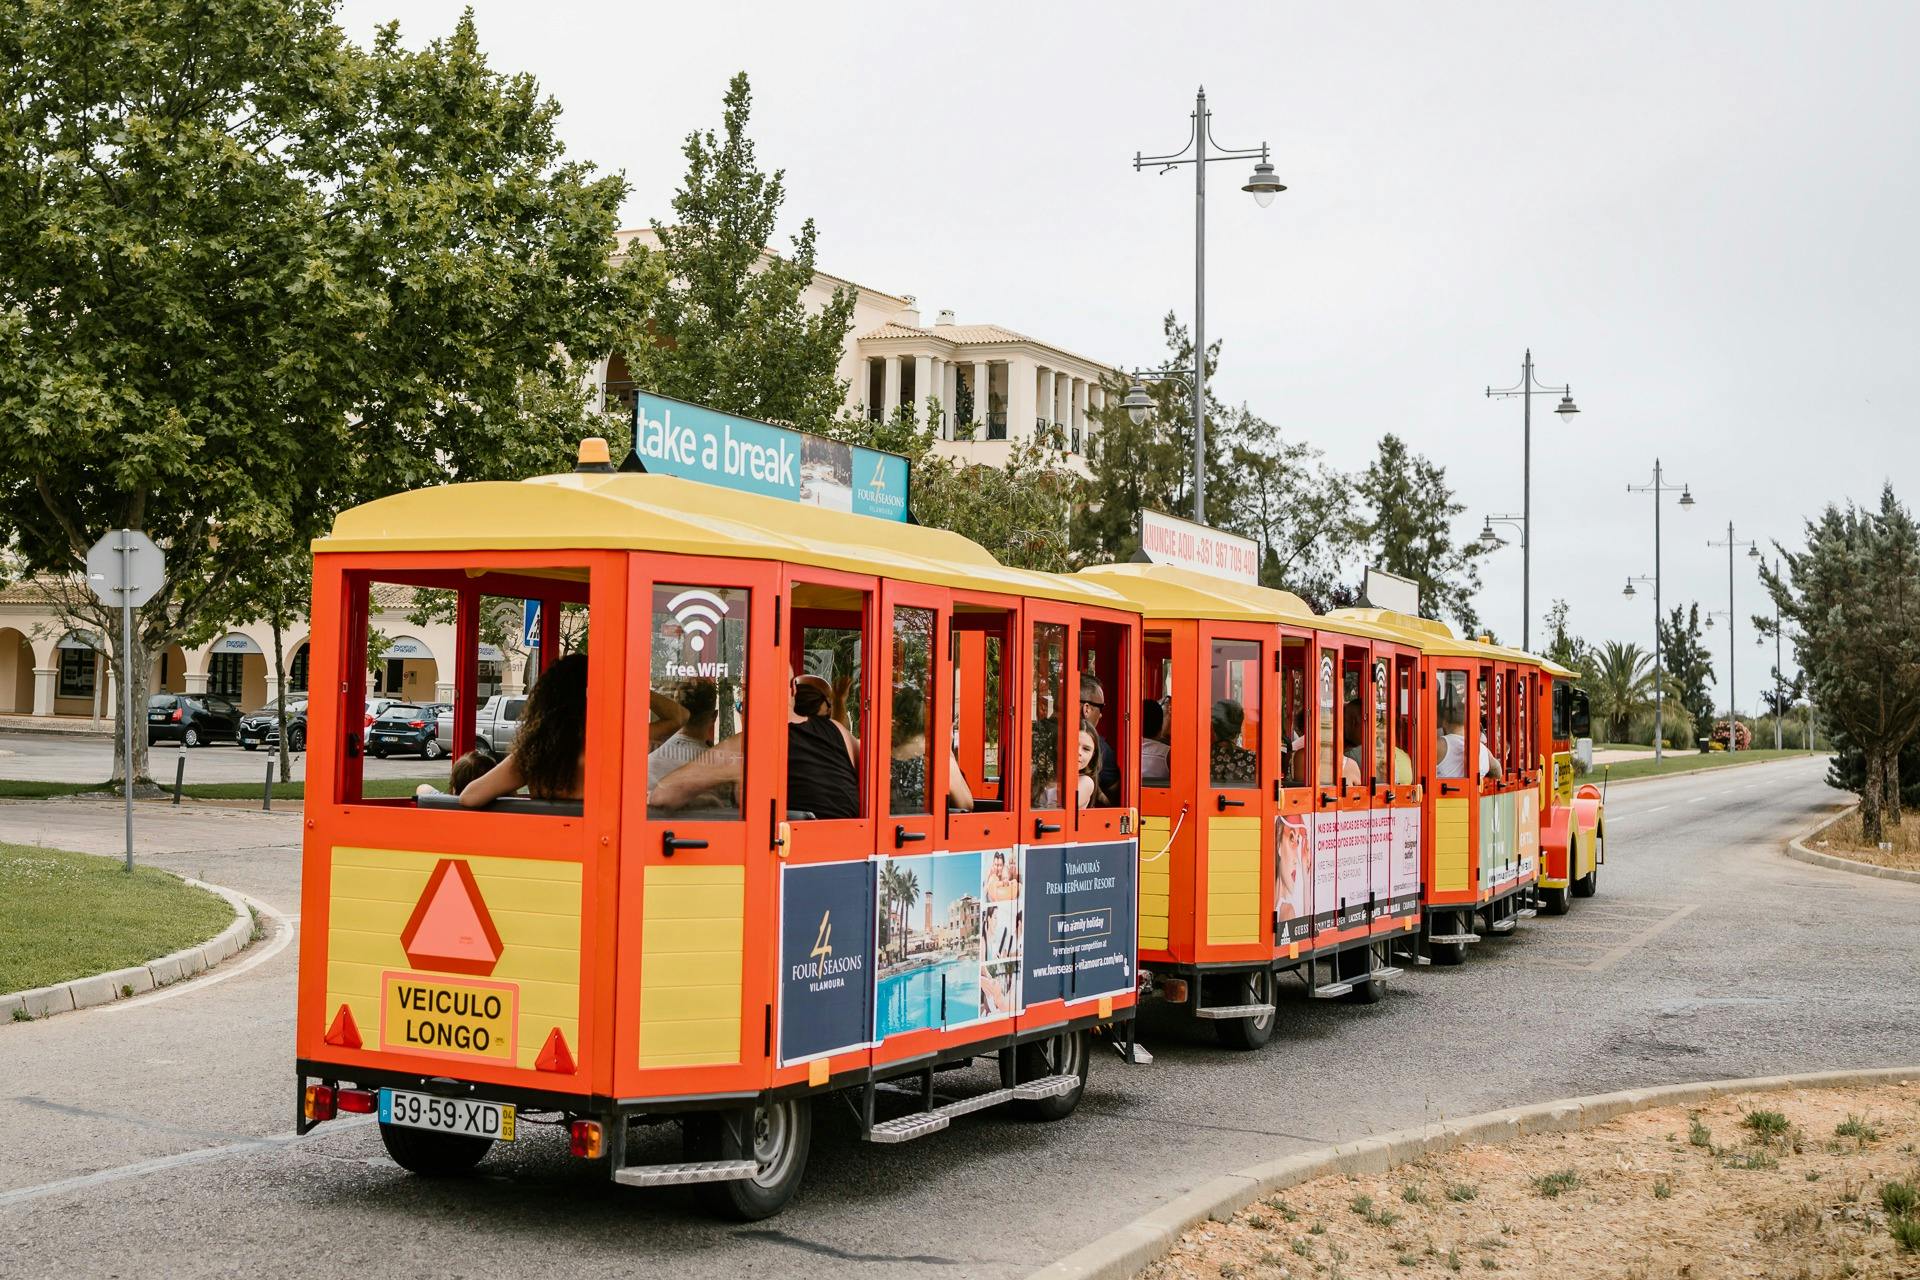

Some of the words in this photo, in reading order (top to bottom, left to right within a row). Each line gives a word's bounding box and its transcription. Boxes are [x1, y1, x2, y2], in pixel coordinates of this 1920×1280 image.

[637, 407, 697, 465] take
[702, 433, 718, 471] a
[724, 425, 795, 487] break
[869, 455, 886, 504] 4
[857, 488, 875, 502] FOUR
[878, 493, 905, 507] SEASONS
[1144, 523, 1176, 557] ANUNCIE
[1178, 532, 1195, 562] AQUI
[1197, 537, 1213, 565] +351
[1215, 541, 1228, 569] 967
[1230, 545, 1242, 573] 709
[1243, 549, 1256, 577] 400
[665, 661, 698, 677] free
[698, 662, 729, 677] WiFi
[1094, 876, 1115, 890] RESORT
[1057, 921, 1069, 933] Win
[1086, 916, 1104, 929] holiday
[1295, 923, 1309, 936] GUESS
[810, 909, 833, 979] 4
[792, 962, 819, 981] FOUR
[823, 954, 862, 976] SEASONS
[809, 978, 845, 992] VILAMOURA
[398, 986, 501, 1020] VEICULO
[406, 1019, 490, 1051] LONGO
[503, 1109, 513, 1120] 04
[502, 1126, 513, 1137] 03
